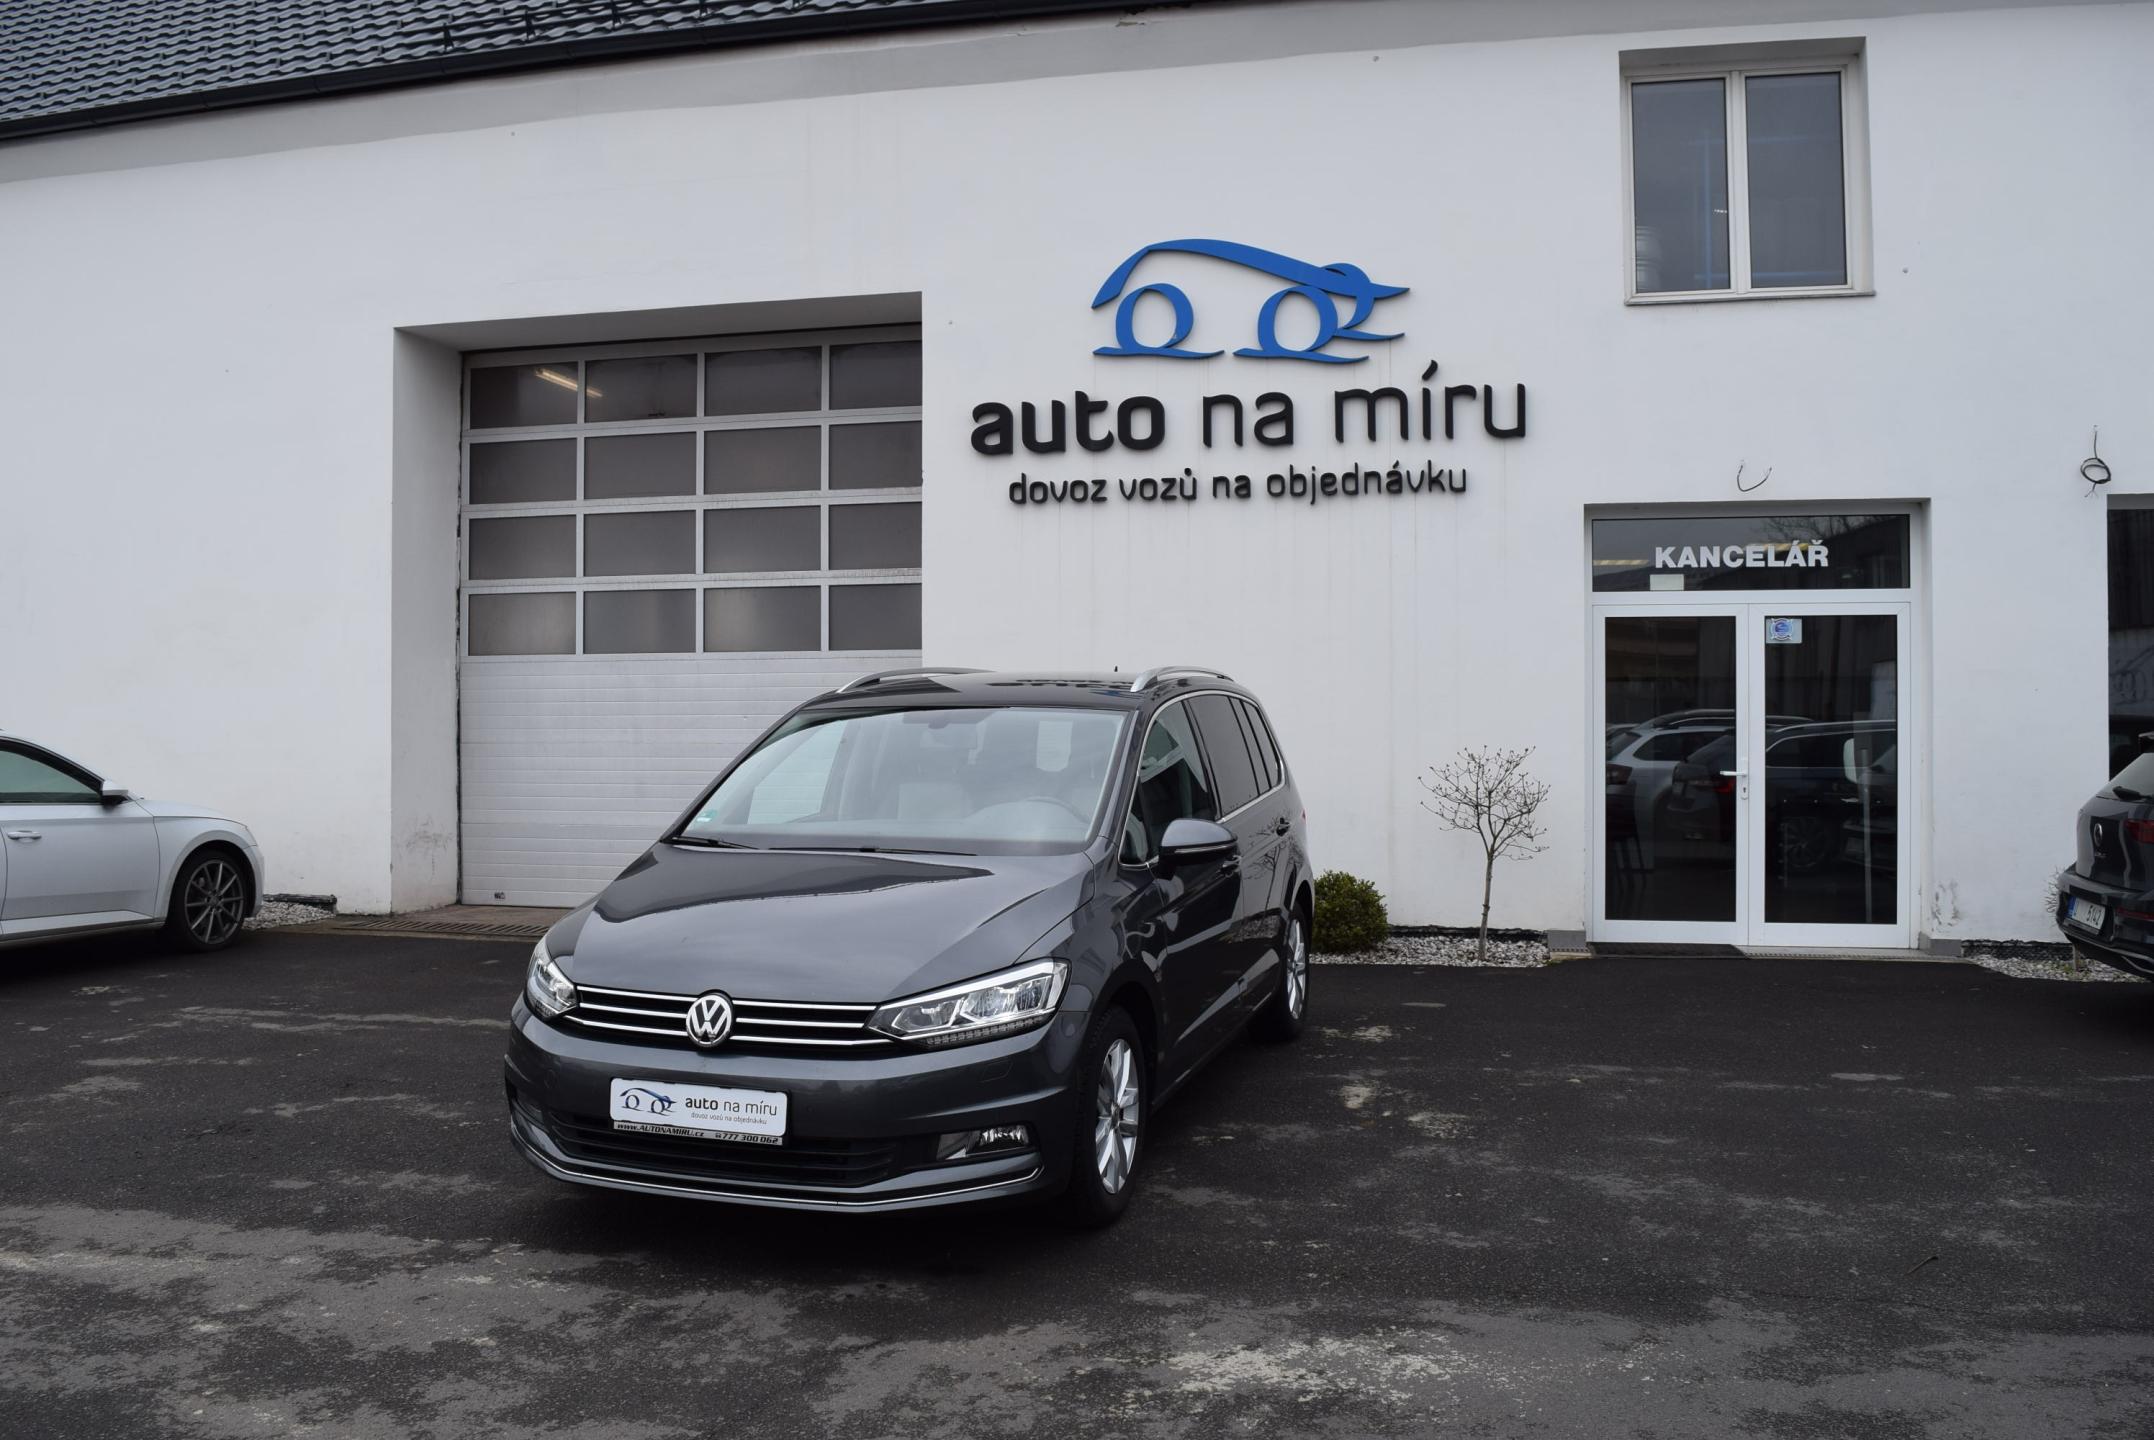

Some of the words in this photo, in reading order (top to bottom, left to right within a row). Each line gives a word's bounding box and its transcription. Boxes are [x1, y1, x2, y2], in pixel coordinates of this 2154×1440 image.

[971, 390, 1166, 456] auto
[1202, 391, 1294, 449] na
[1333, 359, 1527, 443] míru
[1008, 473, 1108, 505] dovoz
[1118, 467, 1198, 501] vozů
[1211, 473, 1251, 499] na
[1265, 459, 1468, 505] objednávku
[1655, 539, 1829, 569] KANCELÁŘ
[685, 1097, 719, 1111] auto
[723, 1101, 740, 1113] na
[745, 1100, 778, 1116] míru
